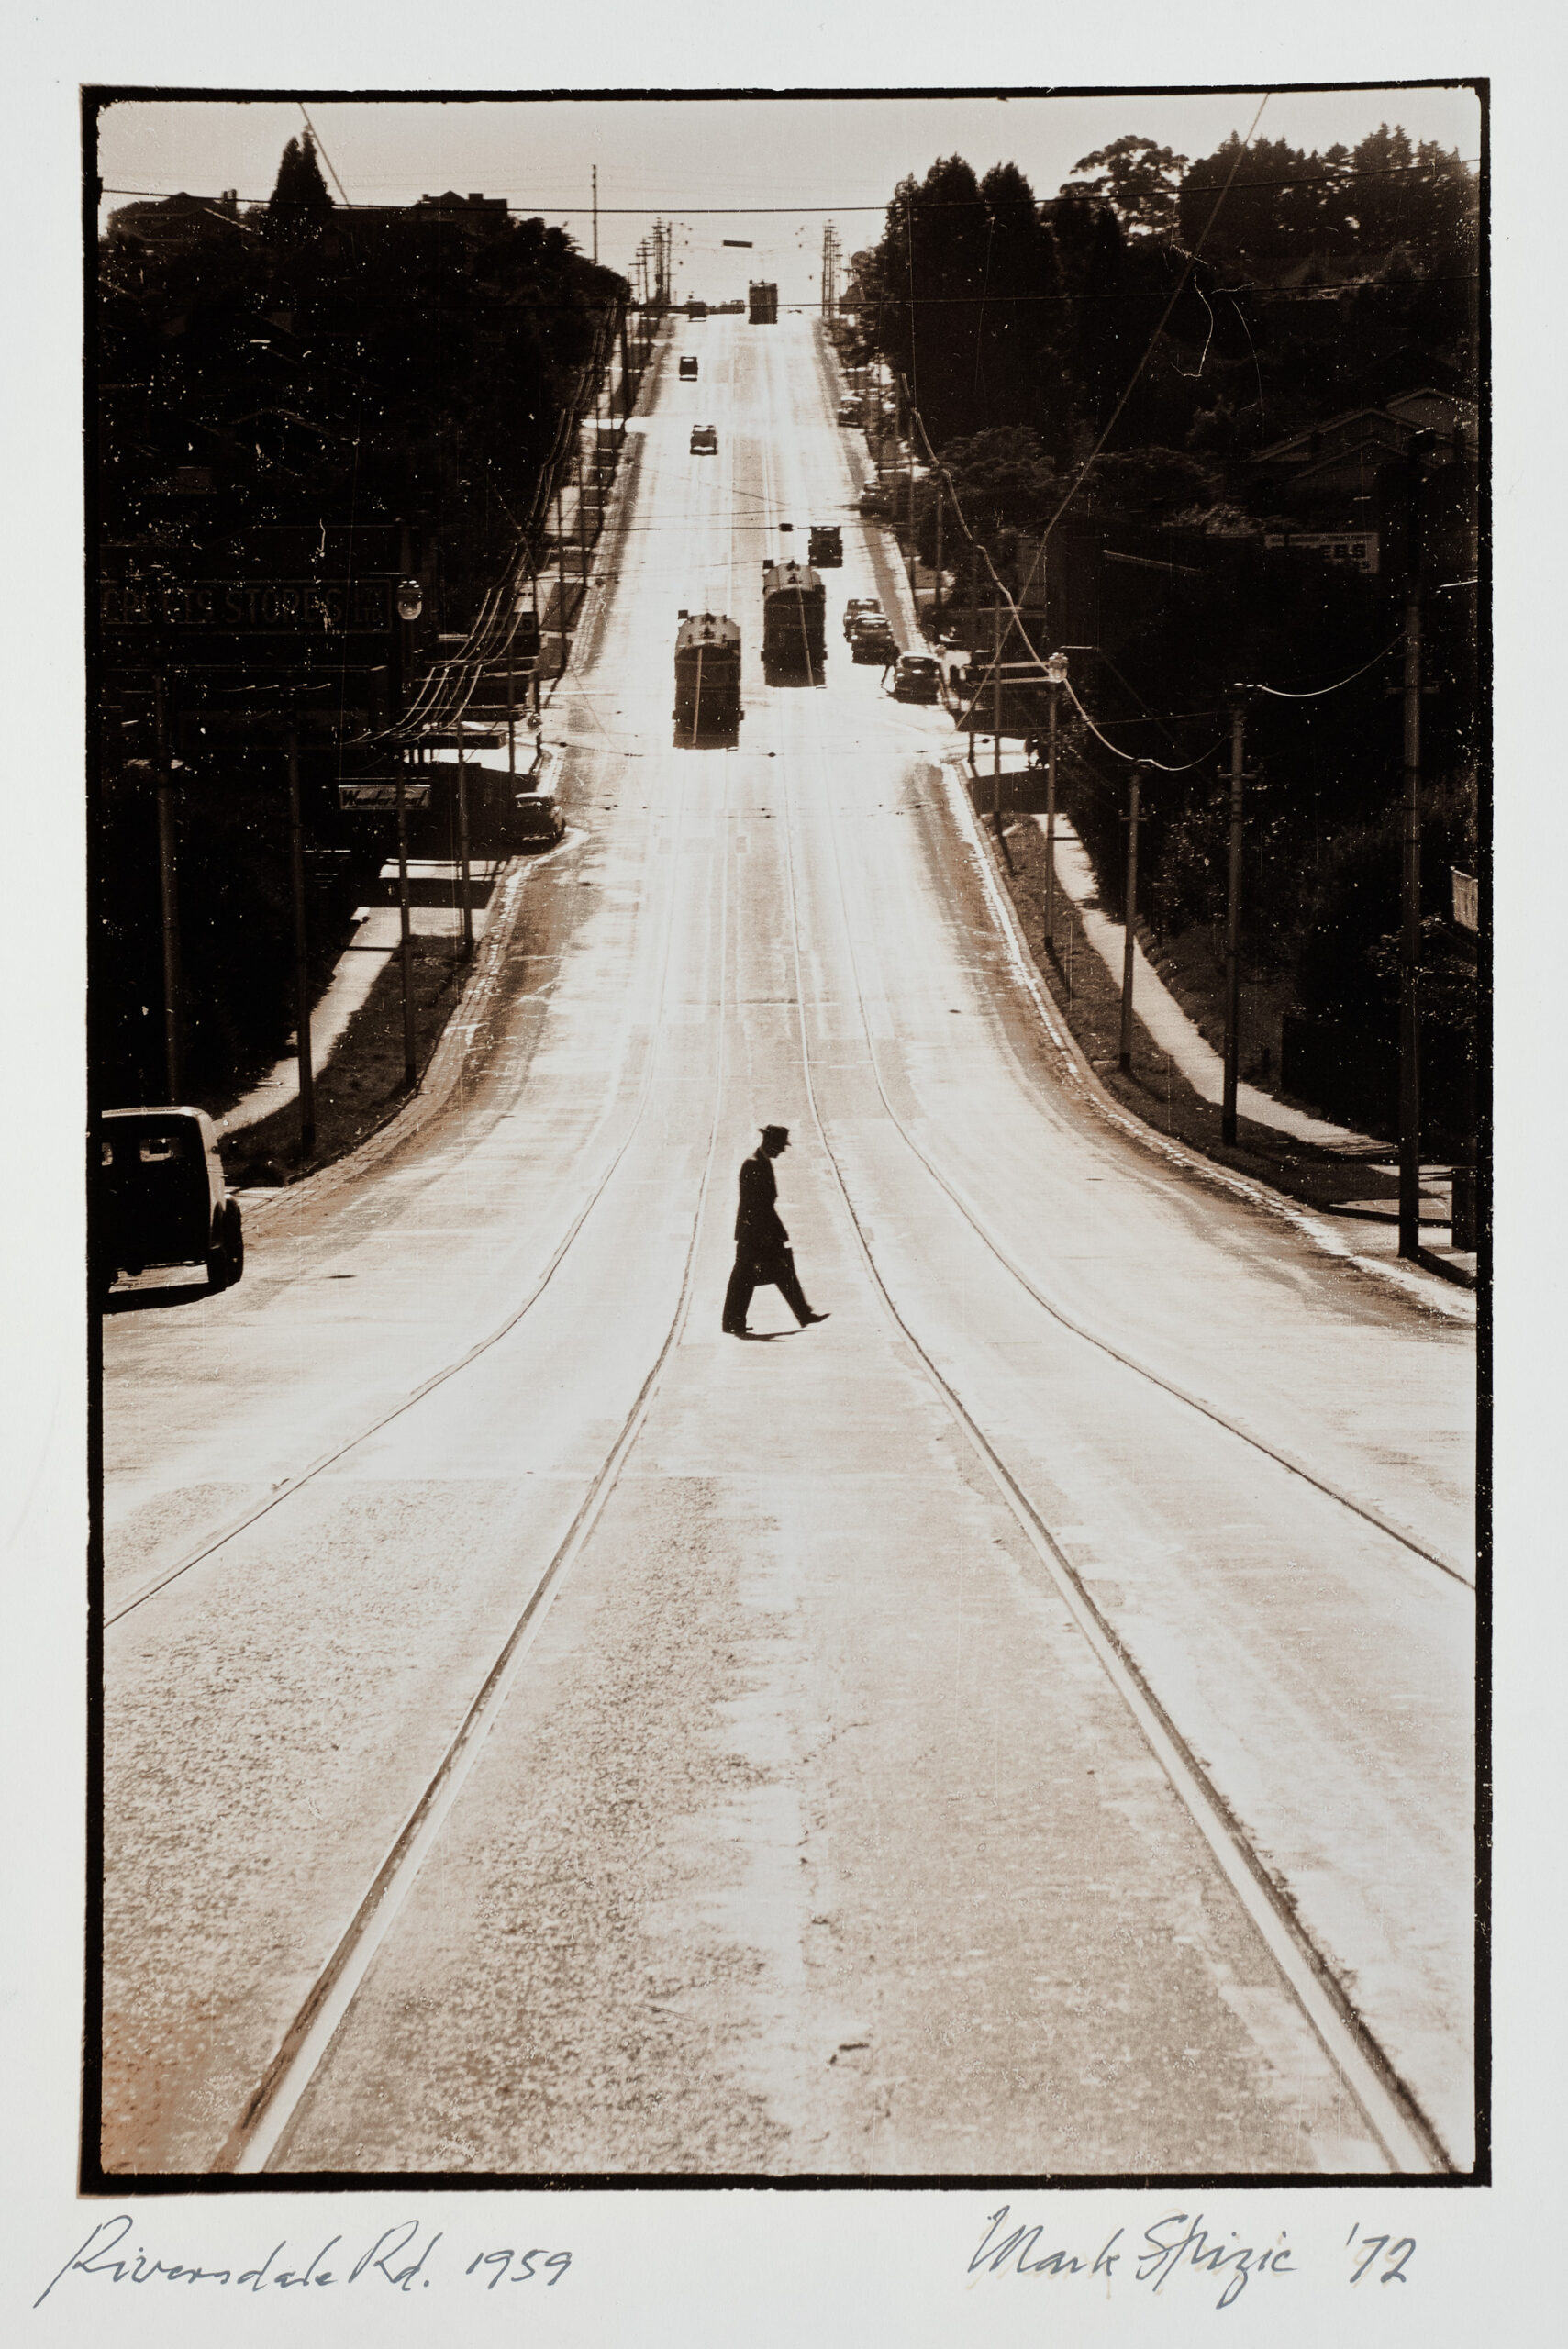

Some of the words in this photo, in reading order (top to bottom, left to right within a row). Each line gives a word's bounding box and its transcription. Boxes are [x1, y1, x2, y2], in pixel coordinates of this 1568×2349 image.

[225, 588, 342, 623] STORES
[32, 2214, 343, 2310] Riversdale
[348, 2220, 443, 2292] Rd.
[465, 2248, 573, 2290] 1959
[967, 2205, 1121, 2277] Mark
[1345, 2222, 1417, 2288] '72
